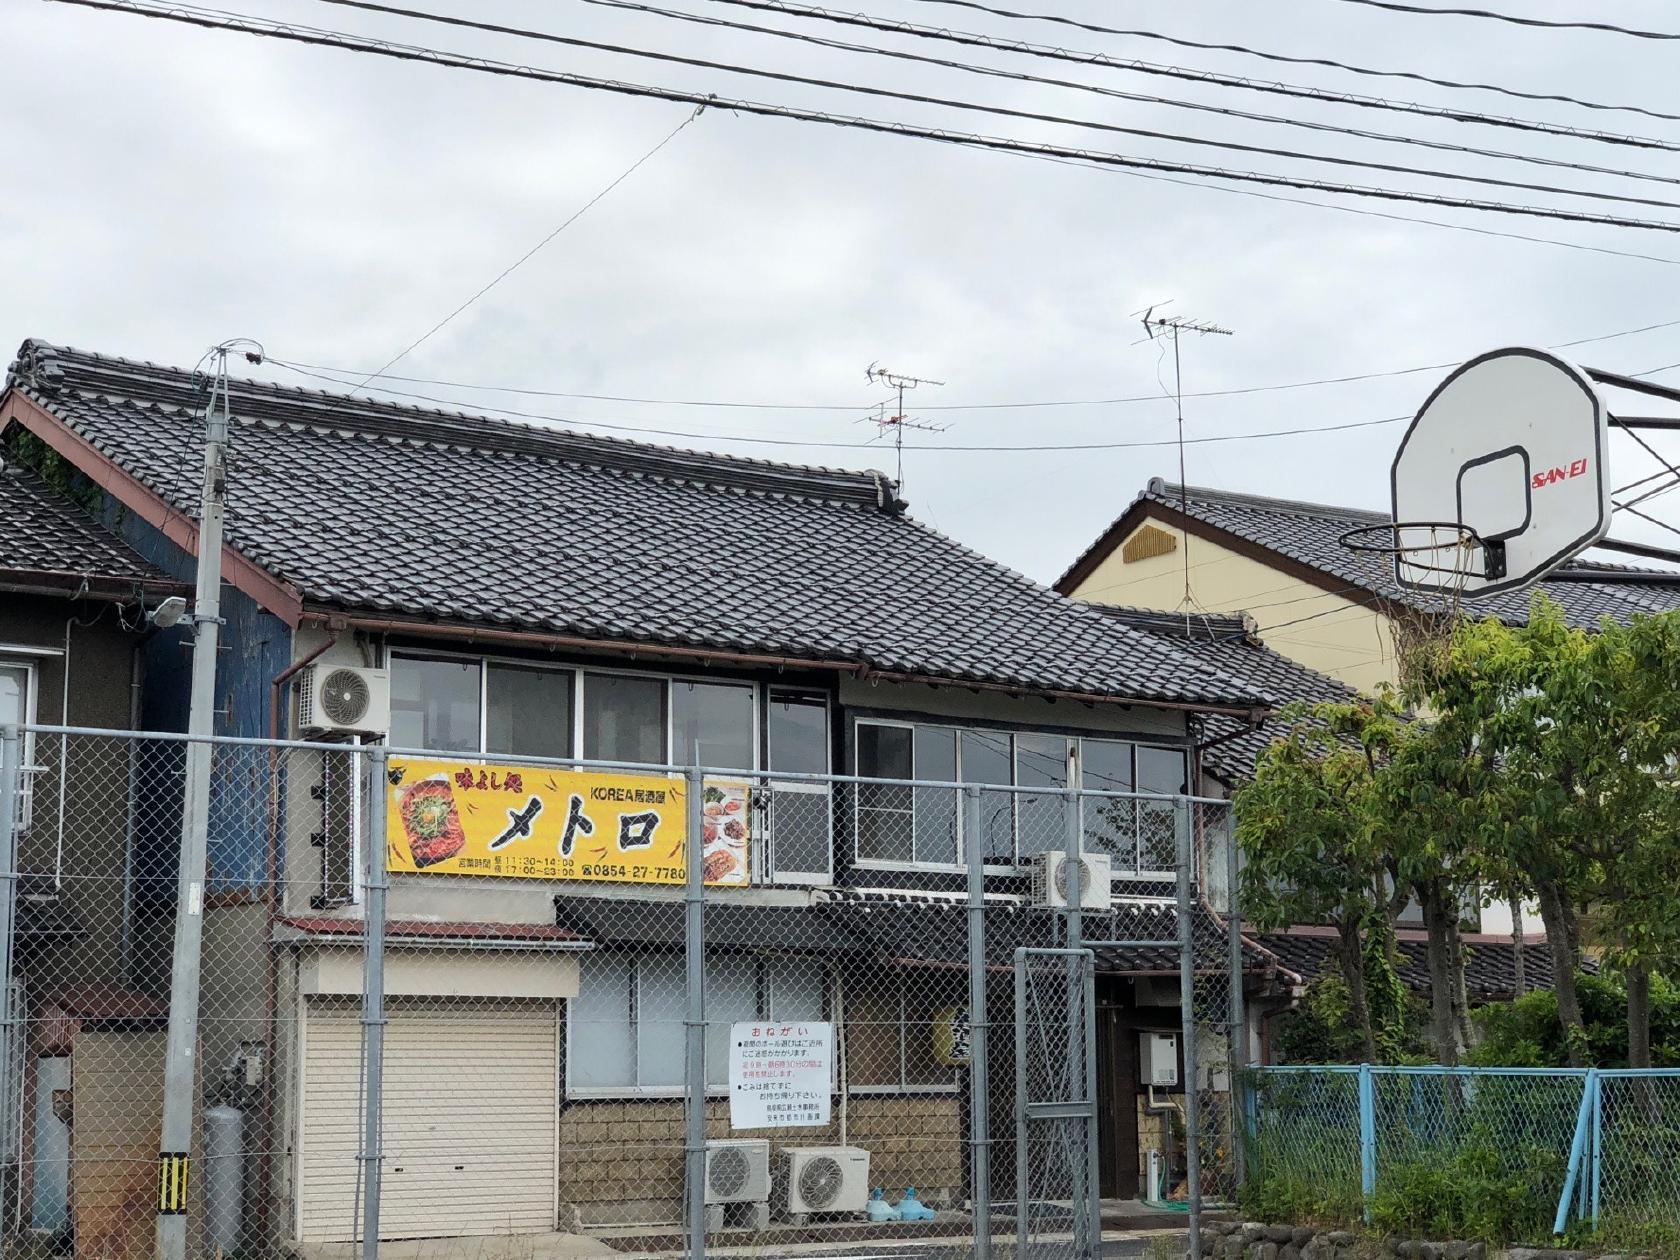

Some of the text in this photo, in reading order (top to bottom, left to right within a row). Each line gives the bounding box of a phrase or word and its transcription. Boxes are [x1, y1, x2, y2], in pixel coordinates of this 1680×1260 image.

[1531, 458, 1587, 489] SAN-EI
[454, 767, 523, 794] 味よし処
[590, 787, 666, 804] KOREA居酒屋
[490, 796, 659, 856] メトロ
[593, 864, 686, 879] 0854-27-7780
[751, 1027, 809, 1038] おねがい
